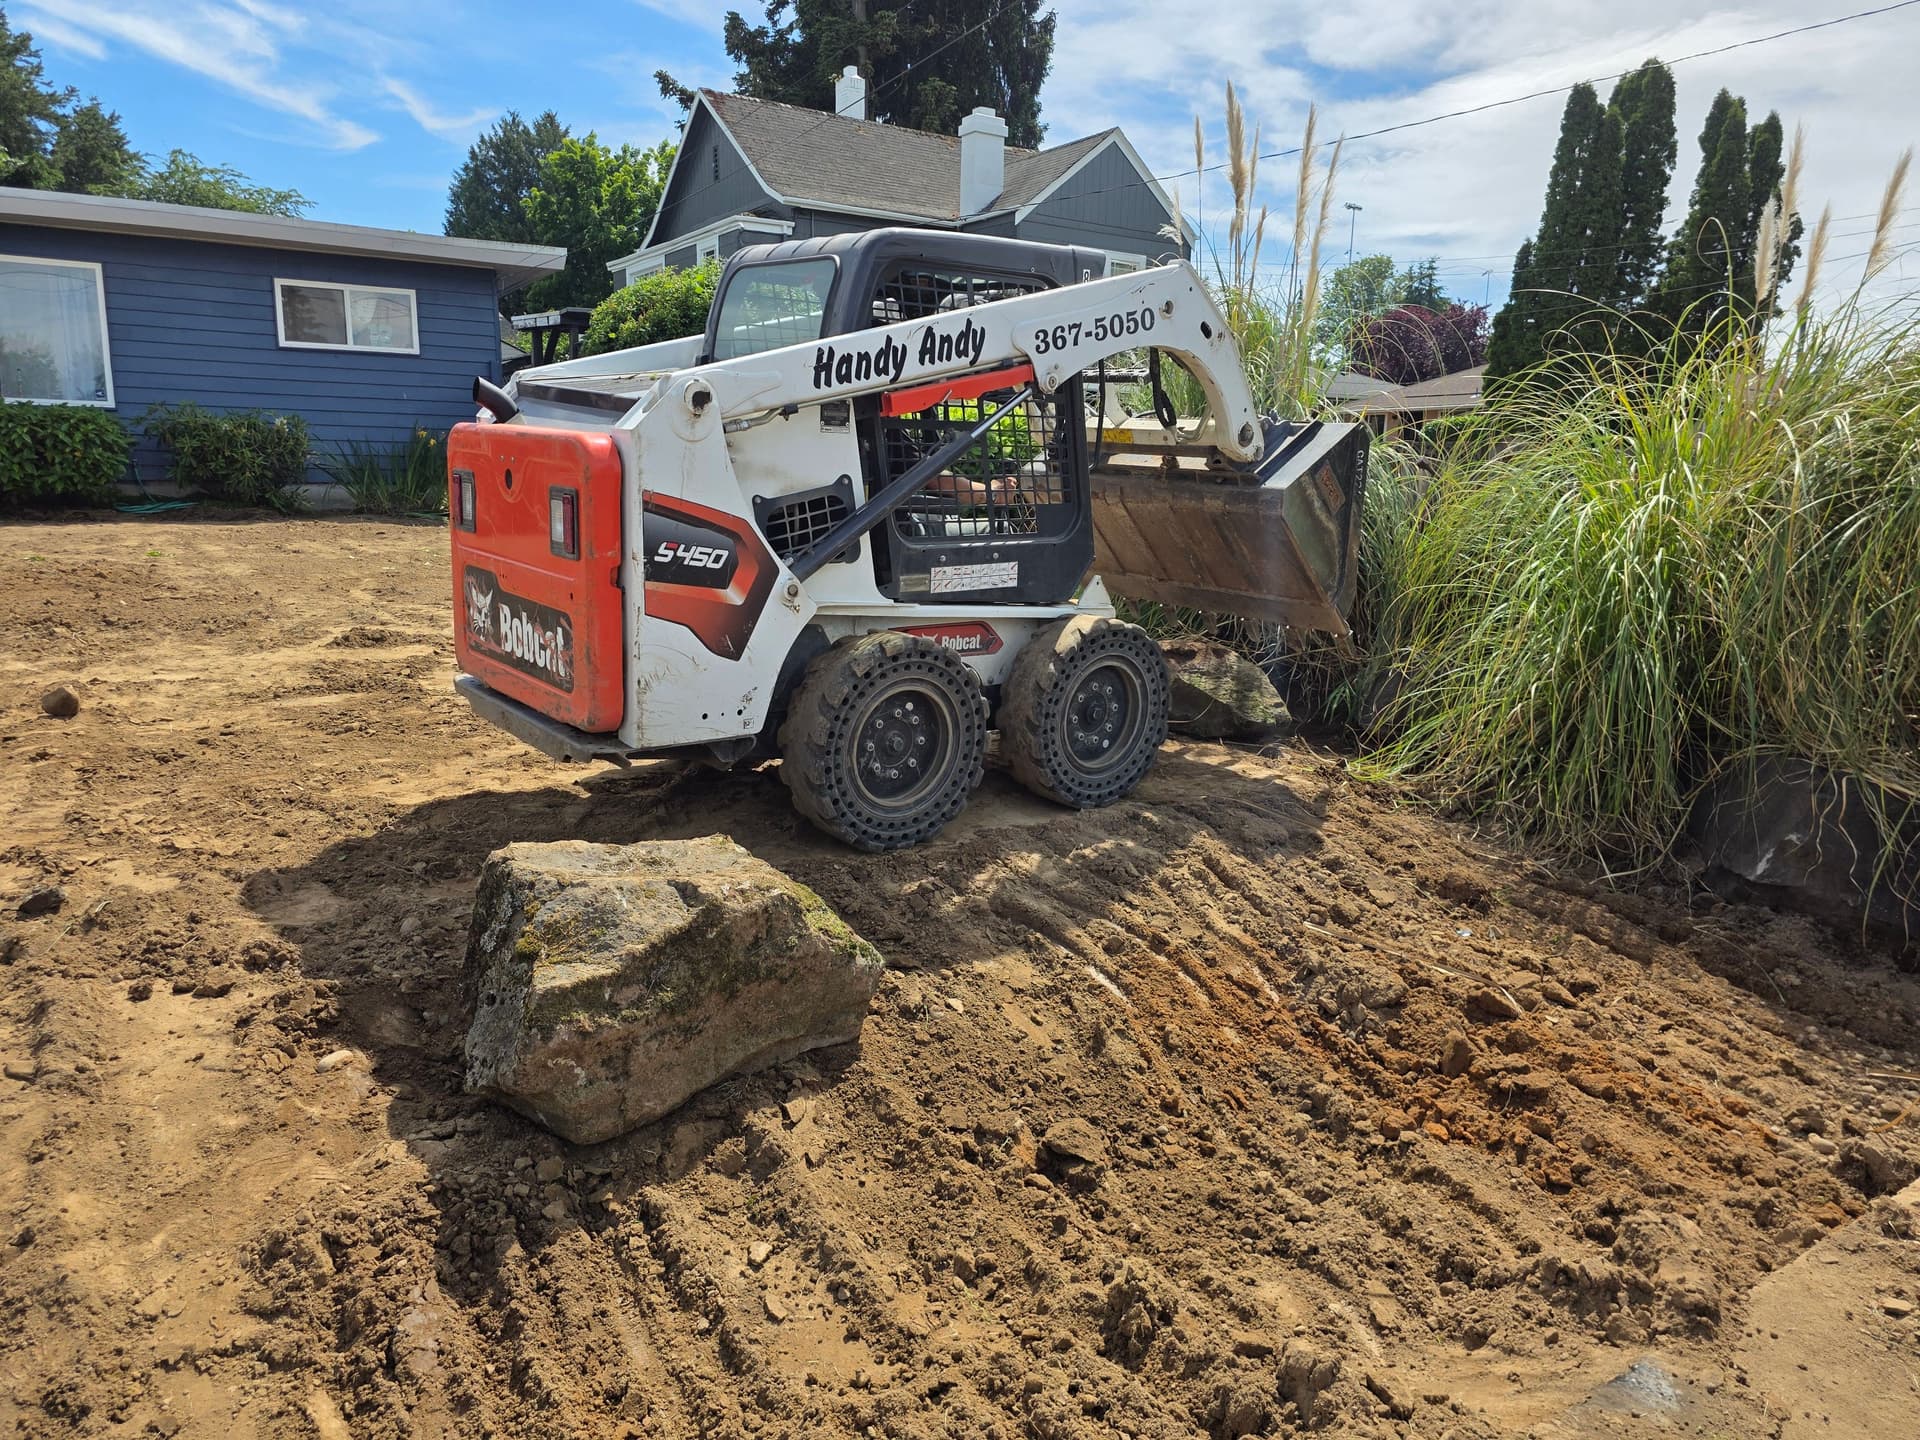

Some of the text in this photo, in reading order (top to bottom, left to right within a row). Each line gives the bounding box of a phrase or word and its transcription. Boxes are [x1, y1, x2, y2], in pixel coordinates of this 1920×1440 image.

[813, 318, 986, 389] Handy Andy
[1035, 307, 1155, 354] 367-5050
[654, 541, 729, 569] S450
[499, 603, 566, 677] Bobcat
[941, 634, 981, 650] Bobcat
